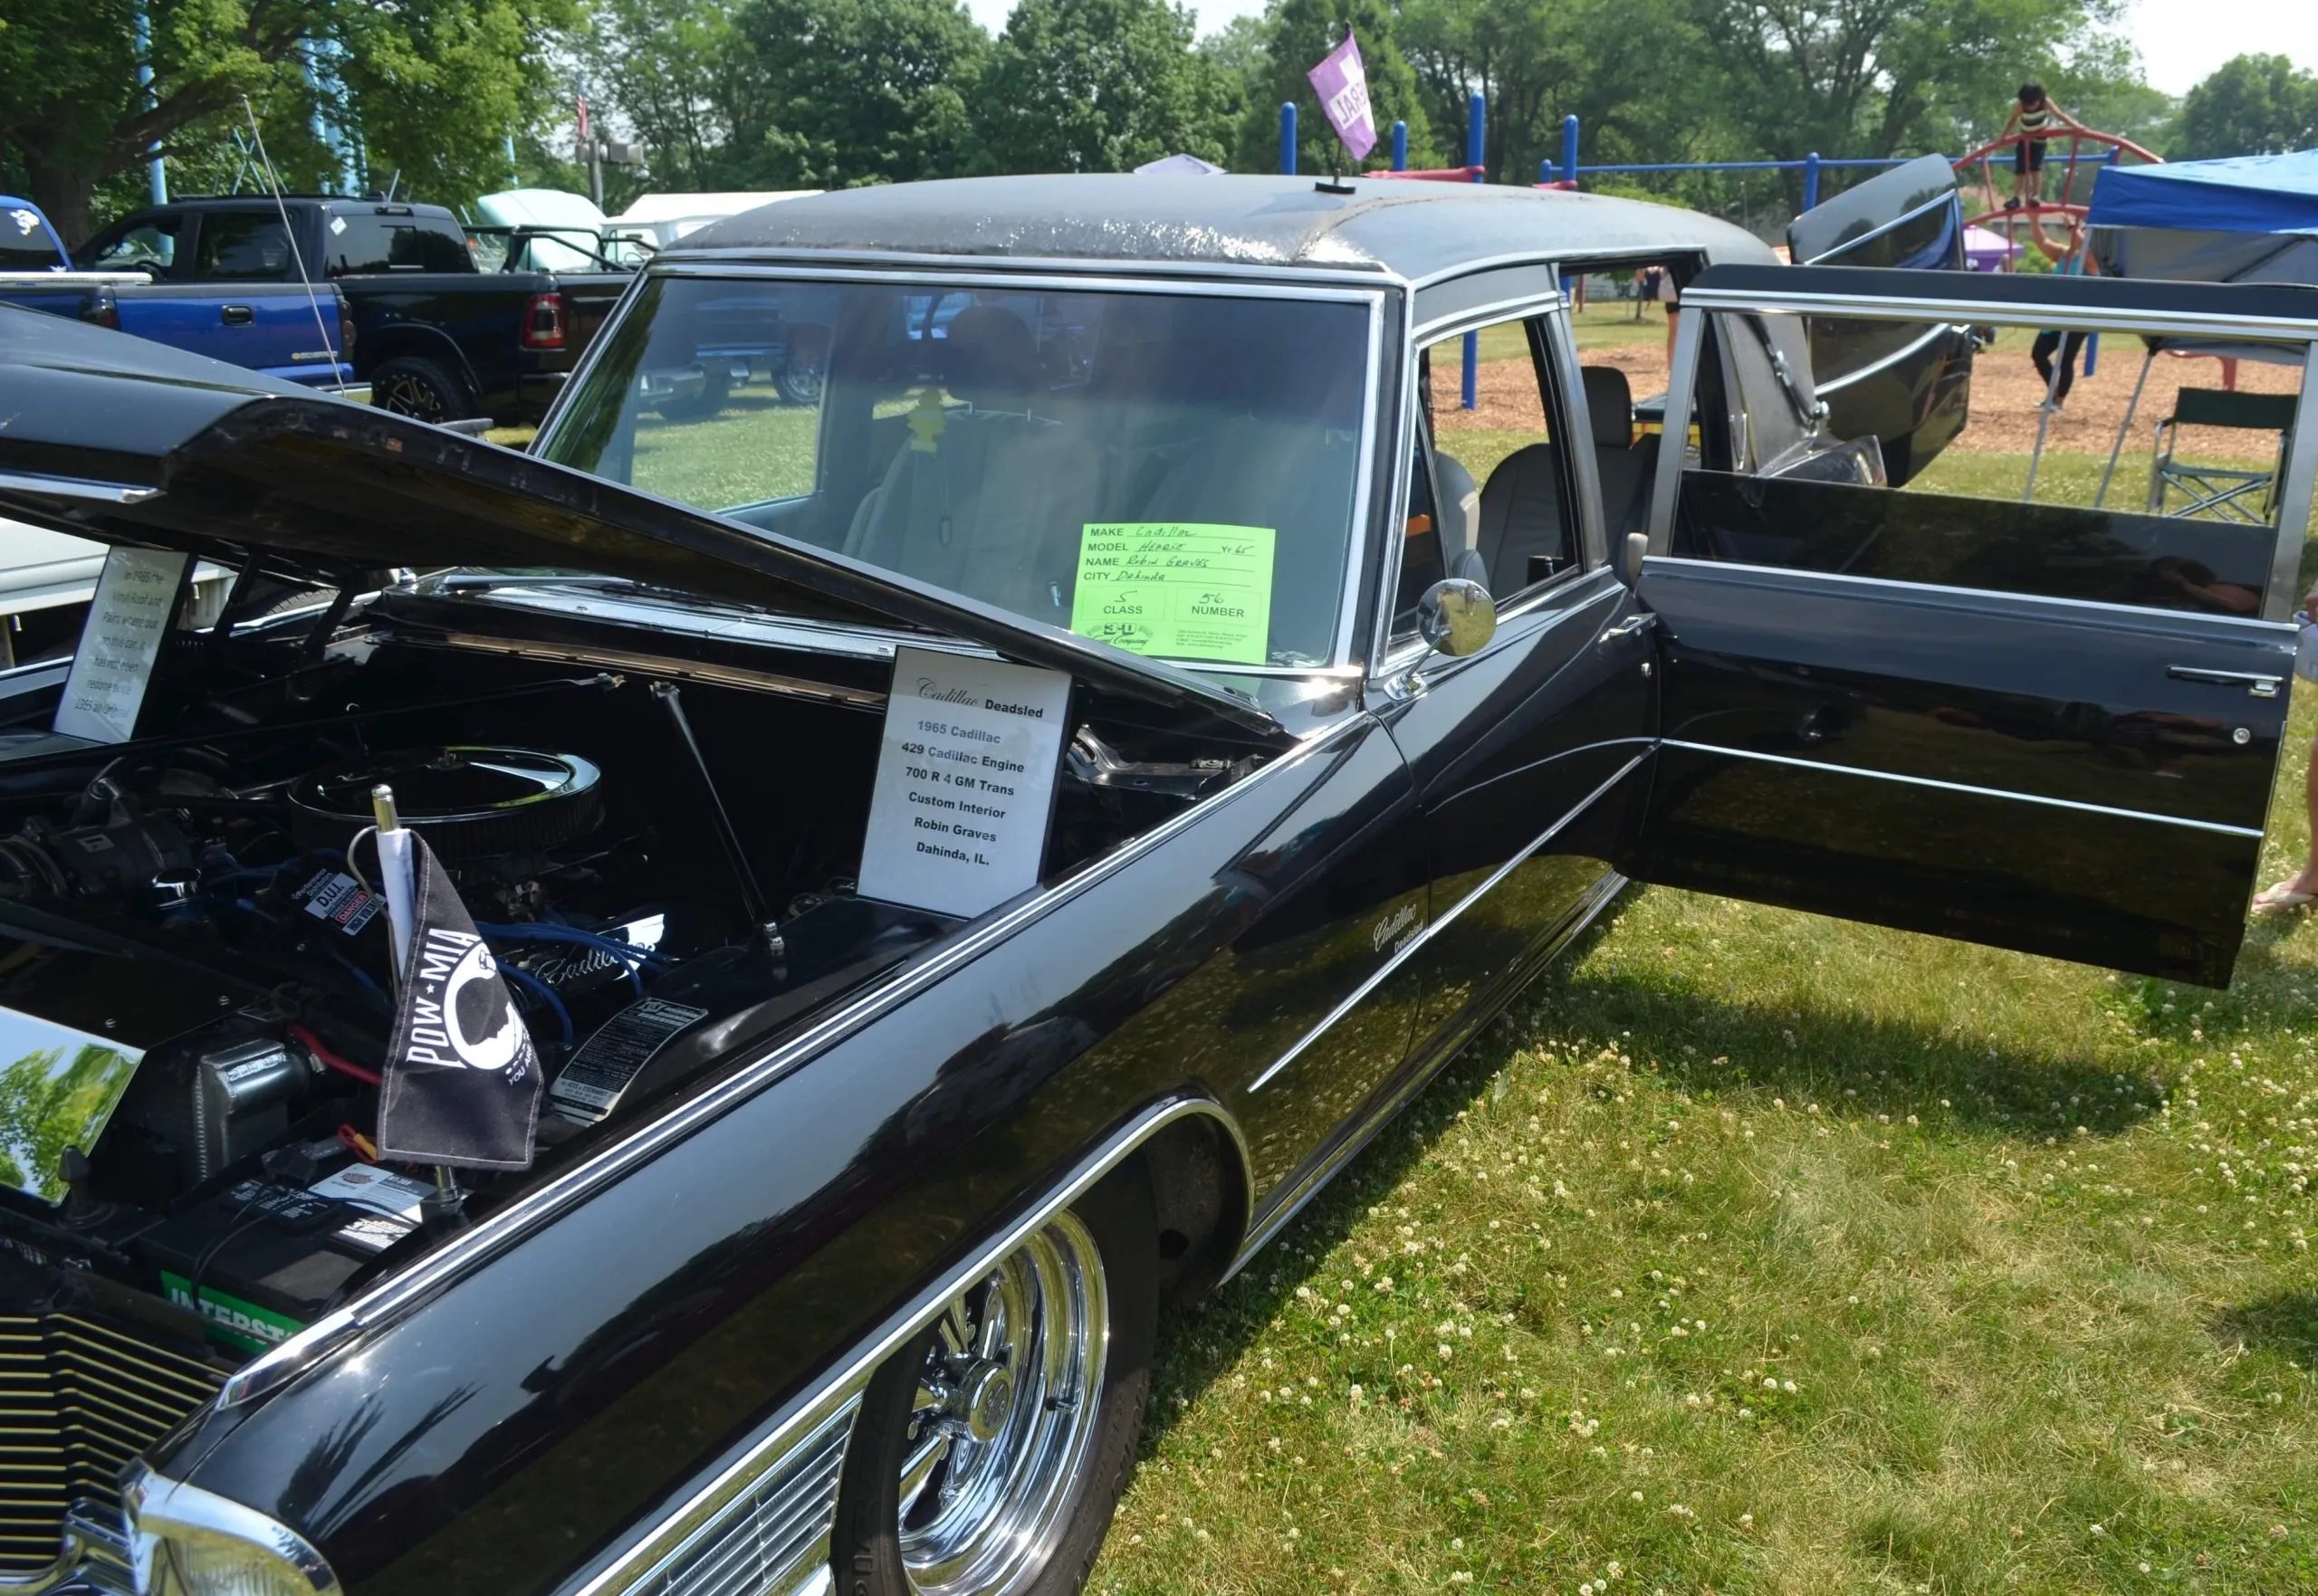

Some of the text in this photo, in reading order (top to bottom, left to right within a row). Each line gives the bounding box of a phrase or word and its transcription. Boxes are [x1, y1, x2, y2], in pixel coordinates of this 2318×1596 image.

[1090, 529, 1124, 537] MAKE
[1087, 543, 1129, 551] MODEL
[1221, 545, 1232, 553] Yr
[1086, 558, 1119, 566] NAME
[1084, 572, 1110, 580] CITY
[1103, 605, 1144, 615] CLASS
[1199, 592, 1224, 604] 56
[1191, 606, 1245, 617] NUMBER
[916, 677, 1043, 718] Cadillac Deadsled
[917, 720, 1001, 744] 1965 Cadillac
[901, 741, 1025, 773] 429 Cadillac Engine
[905, 767, 1015, 796] 700 R 4 GM Trans
[908, 791, 1006, 819] Custom Interior
[914, 817, 997, 842] Robin Graves
[916, 842, 990, 865] Dahinda, IL.
[316, 883, 345, 907] D.U.I.
[340, 895, 367, 921] DANGER
[1374, 903, 1417, 952] Cadillac
[406, 928, 482, 1070] POW MIA
[508, 1066, 525, 1085] YOU
[170, 1287, 292, 1344] INTERST
